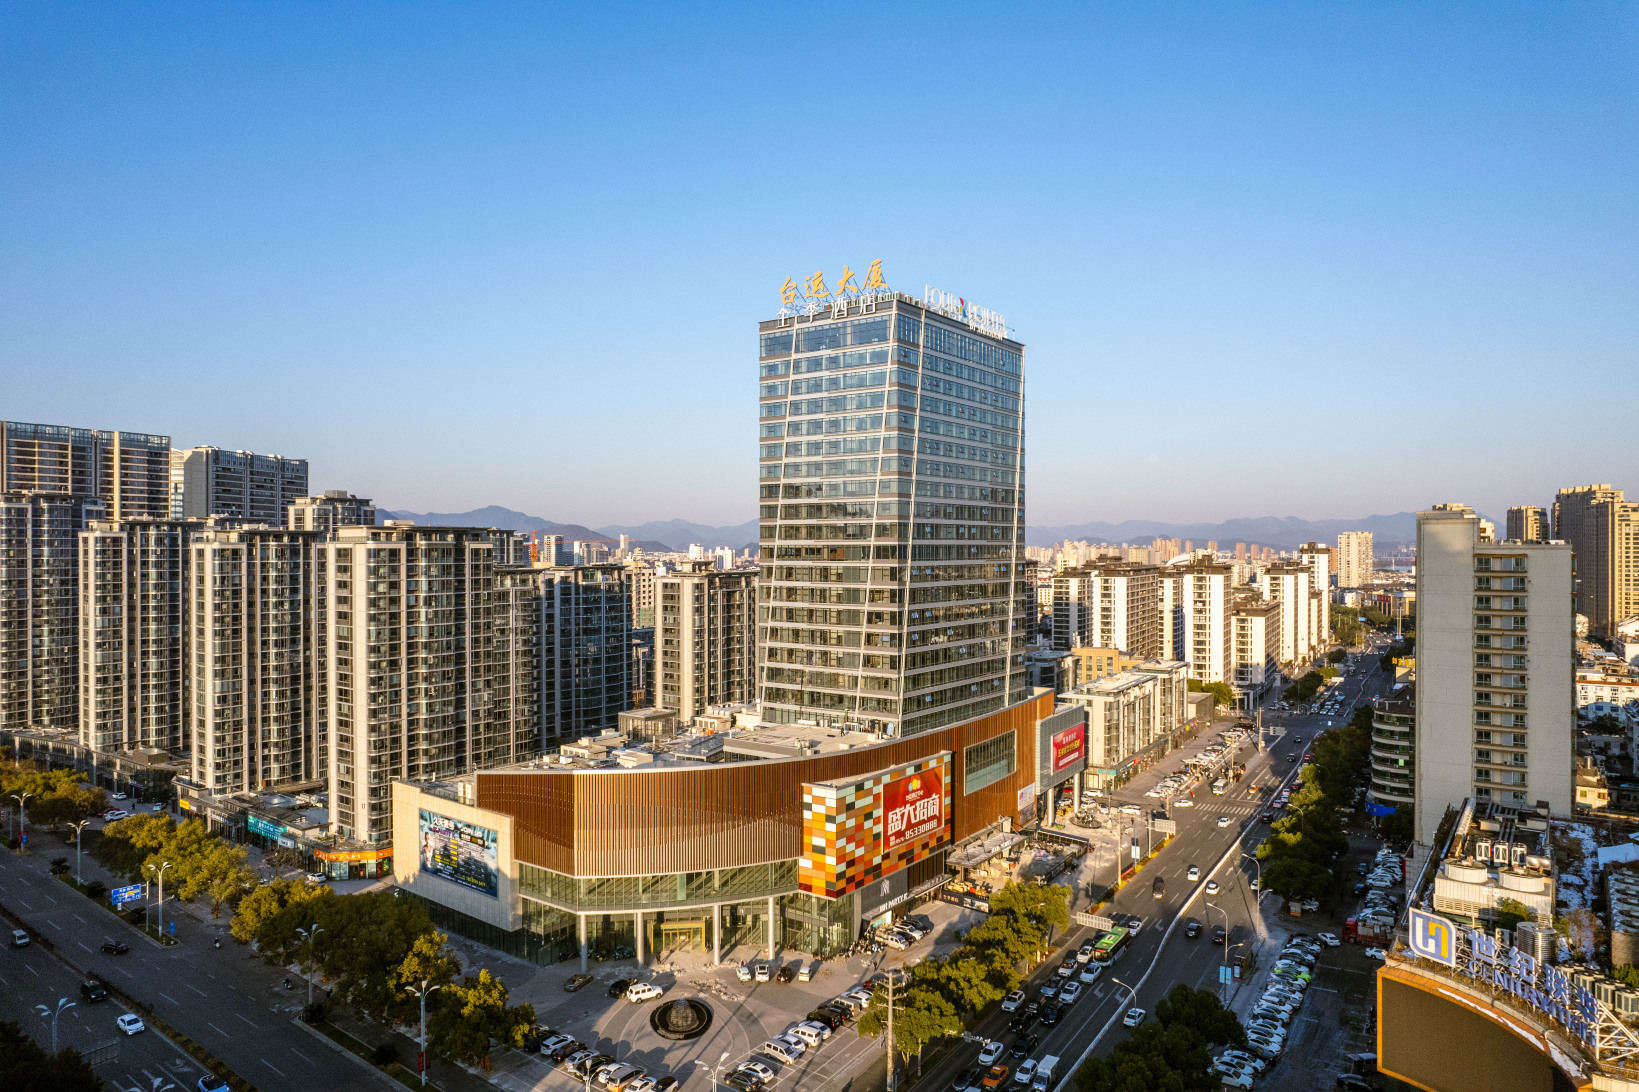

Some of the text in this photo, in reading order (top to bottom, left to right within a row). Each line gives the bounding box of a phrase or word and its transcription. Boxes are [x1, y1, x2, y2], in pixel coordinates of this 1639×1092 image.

[779, 258, 888, 305] 台运大厦
[924, 284, 957, 314] FOUR
[887, 793, 940, 836] 盛大招商
